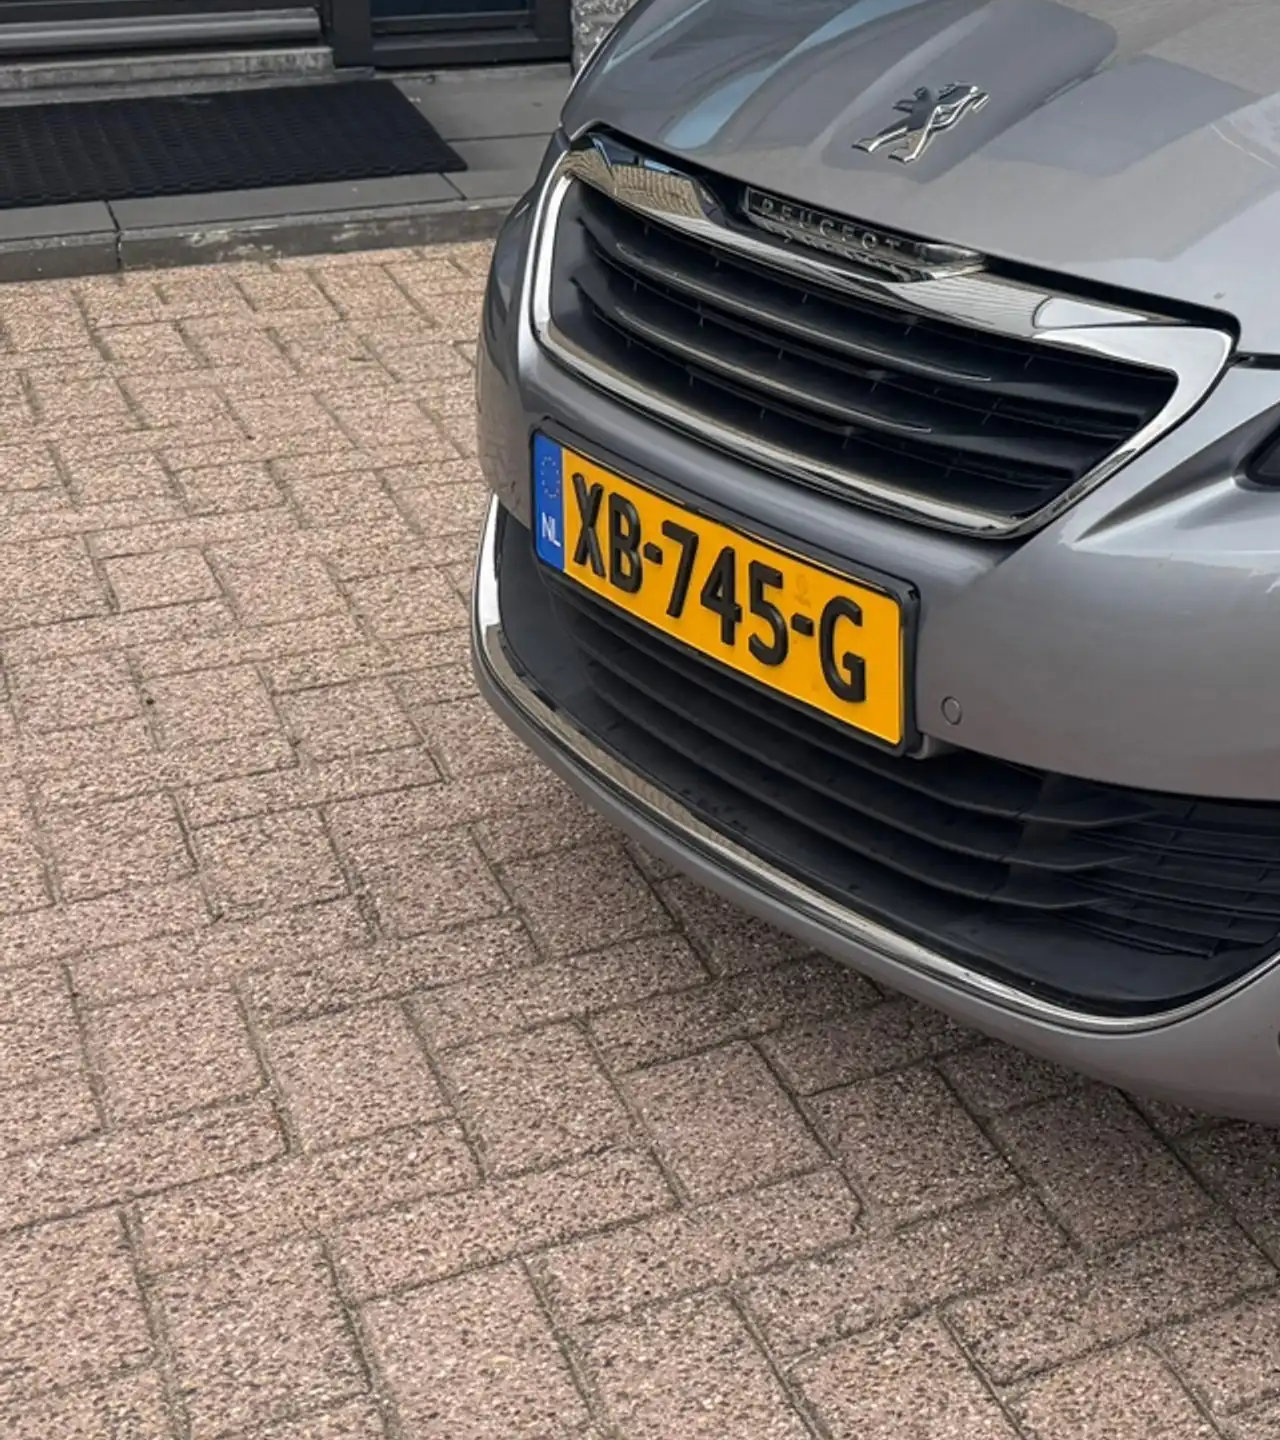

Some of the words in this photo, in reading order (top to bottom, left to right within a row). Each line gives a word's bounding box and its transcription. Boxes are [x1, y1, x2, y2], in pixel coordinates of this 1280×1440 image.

[760, 197, 901, 251] PEUGEOT
[540, 510, 562, 550] NL
[571, 470, 867, 705] XB-745-G
